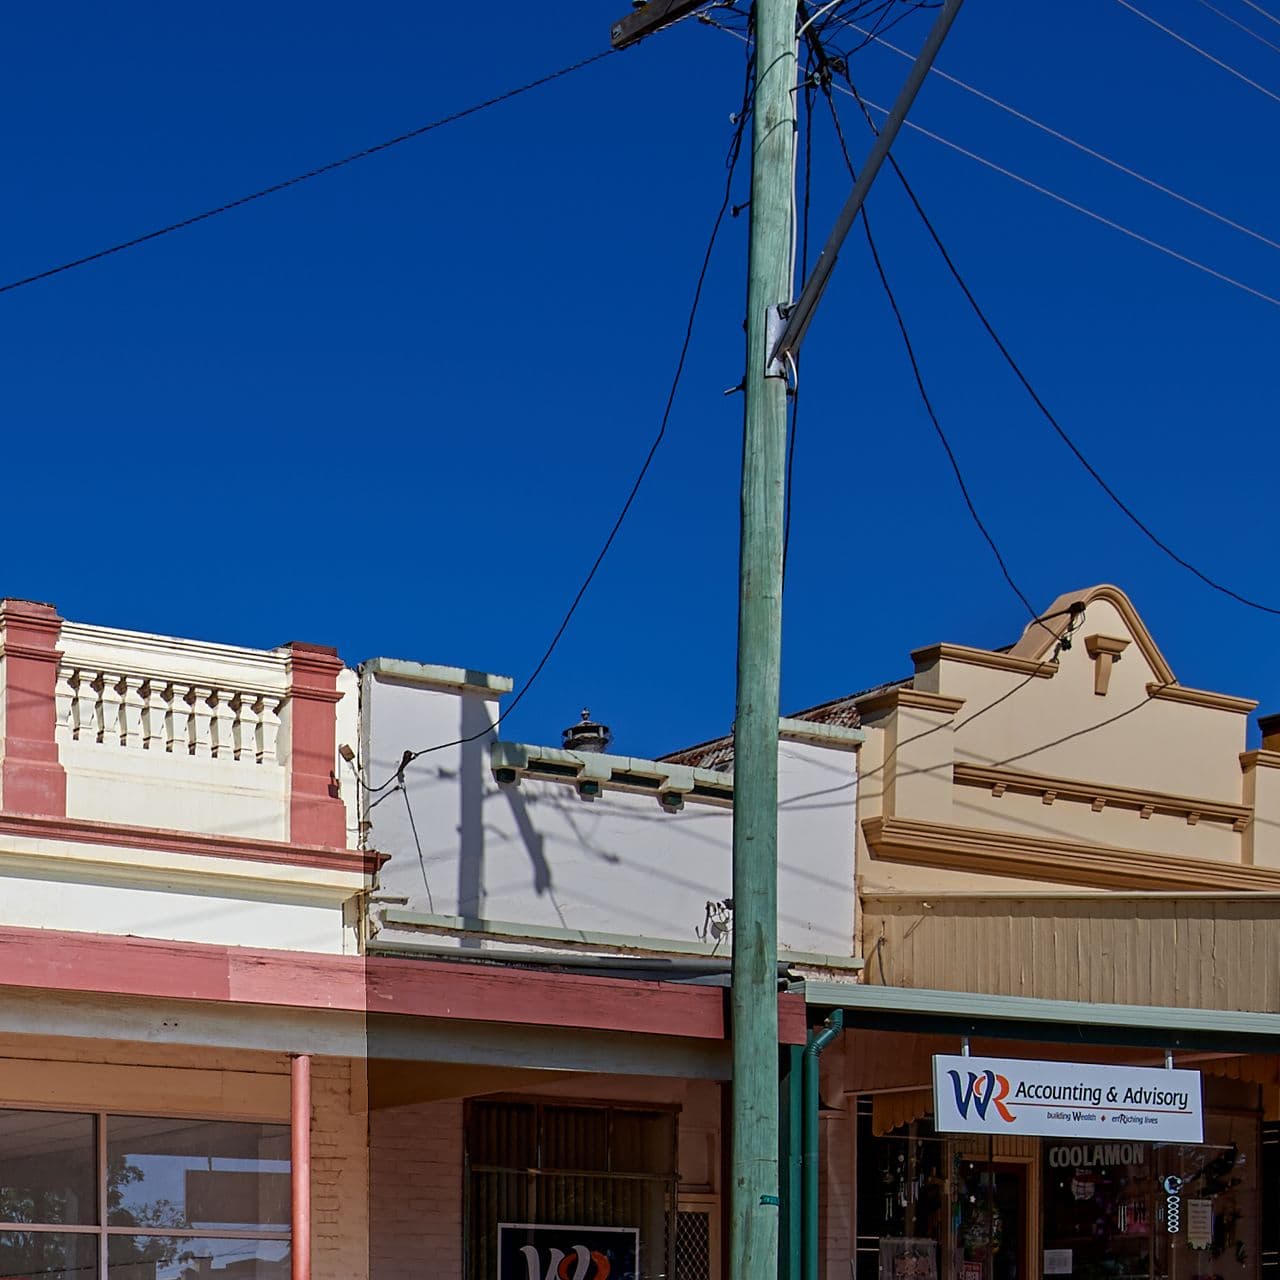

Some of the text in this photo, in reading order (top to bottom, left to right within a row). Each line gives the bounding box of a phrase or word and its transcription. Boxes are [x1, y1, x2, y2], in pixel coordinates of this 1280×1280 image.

[947, 1069, 1017, 1123] WR
[1015, 1081, 1188, 1110] Accounting & Advisory
[1144, 1116, 1158, 1125] lives
[1048, 1143, 1145, 1168] COOLAMON
